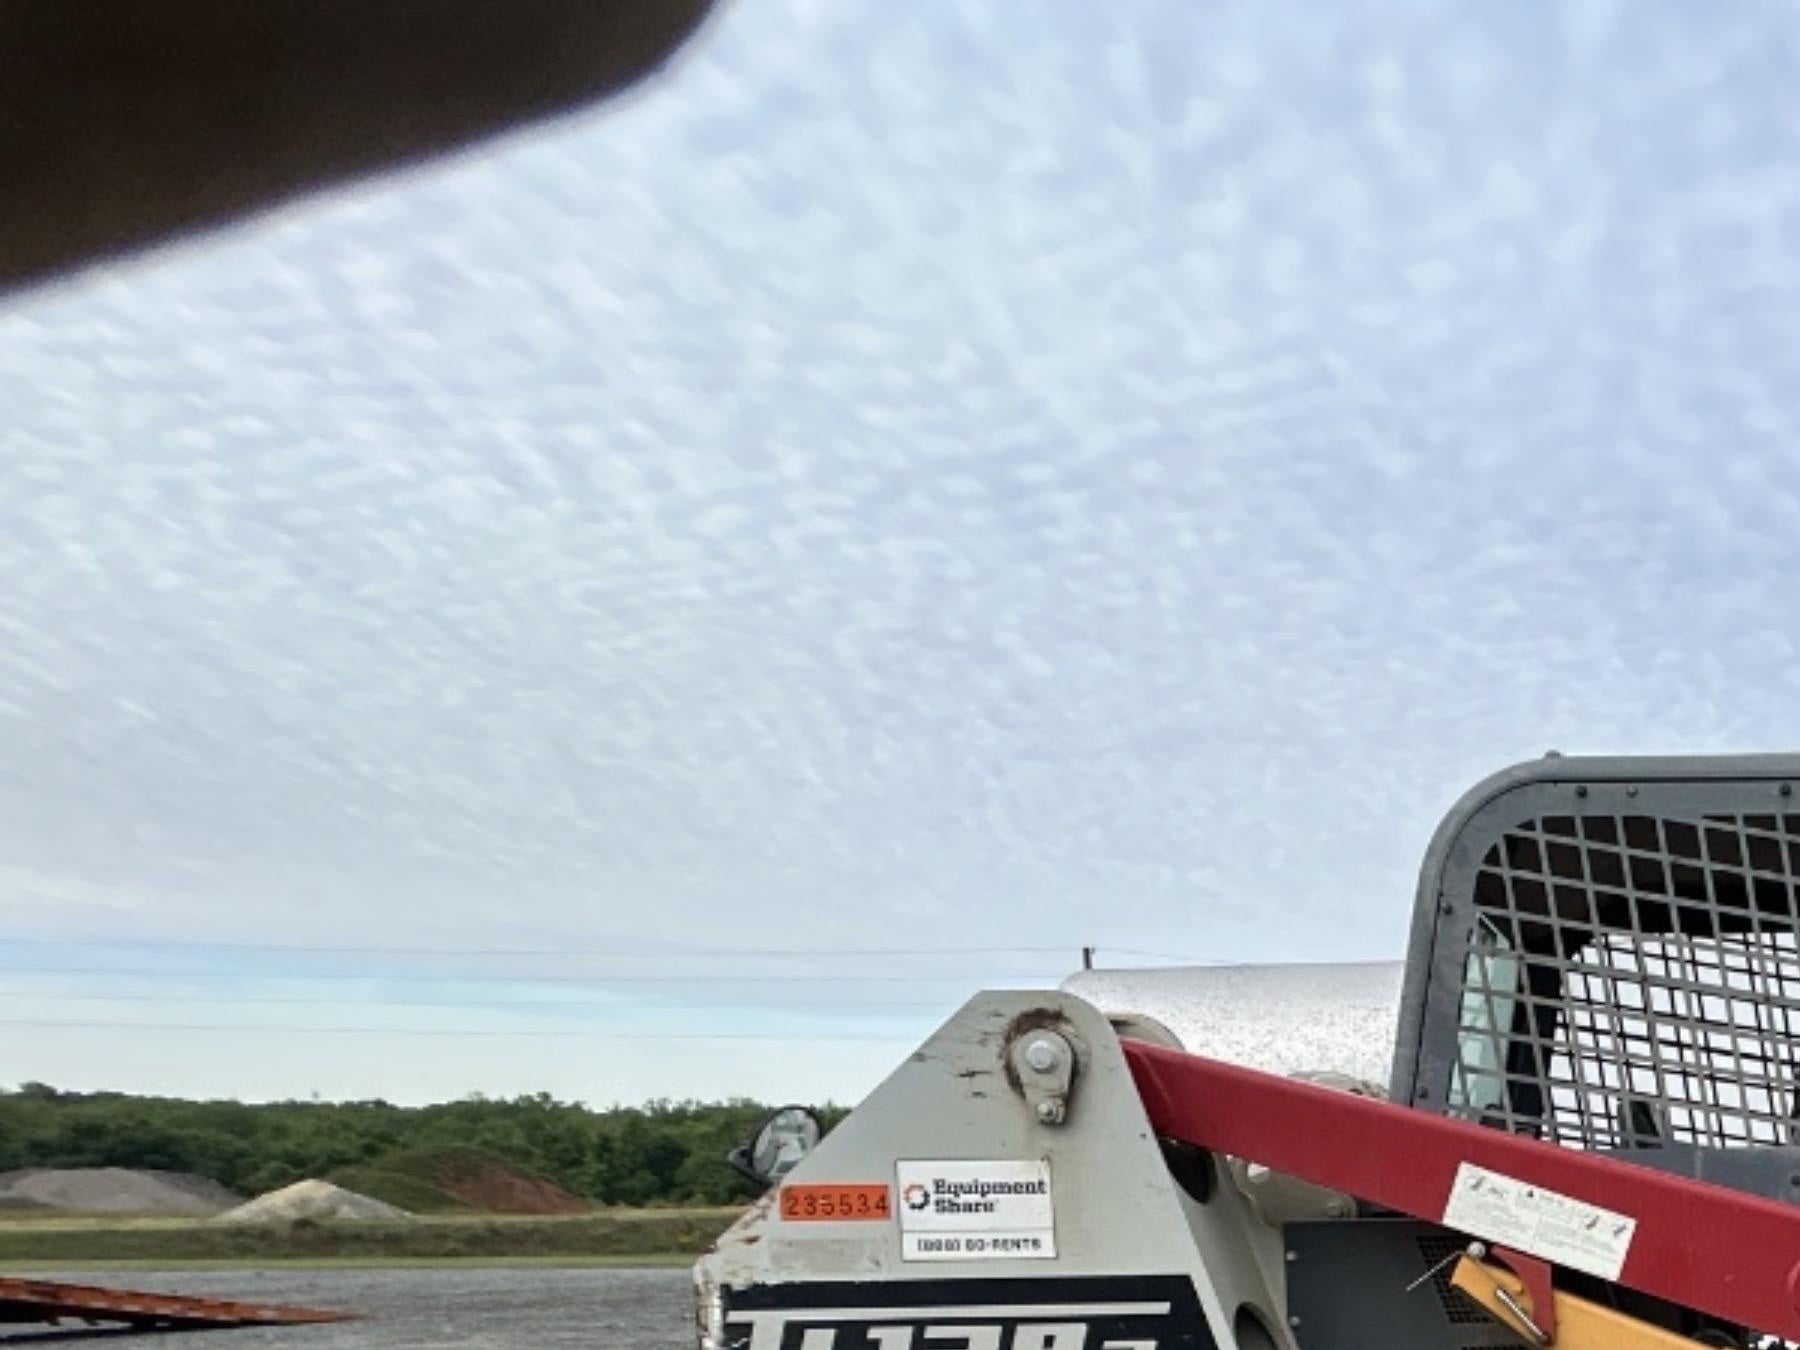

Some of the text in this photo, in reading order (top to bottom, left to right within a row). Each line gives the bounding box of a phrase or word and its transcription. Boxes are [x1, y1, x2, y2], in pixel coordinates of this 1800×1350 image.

[932, 1179, 1047, 1198] Equipment
[784, 1193, 888, 1216] 235534
[934, 1199, 995, 1214] Share
